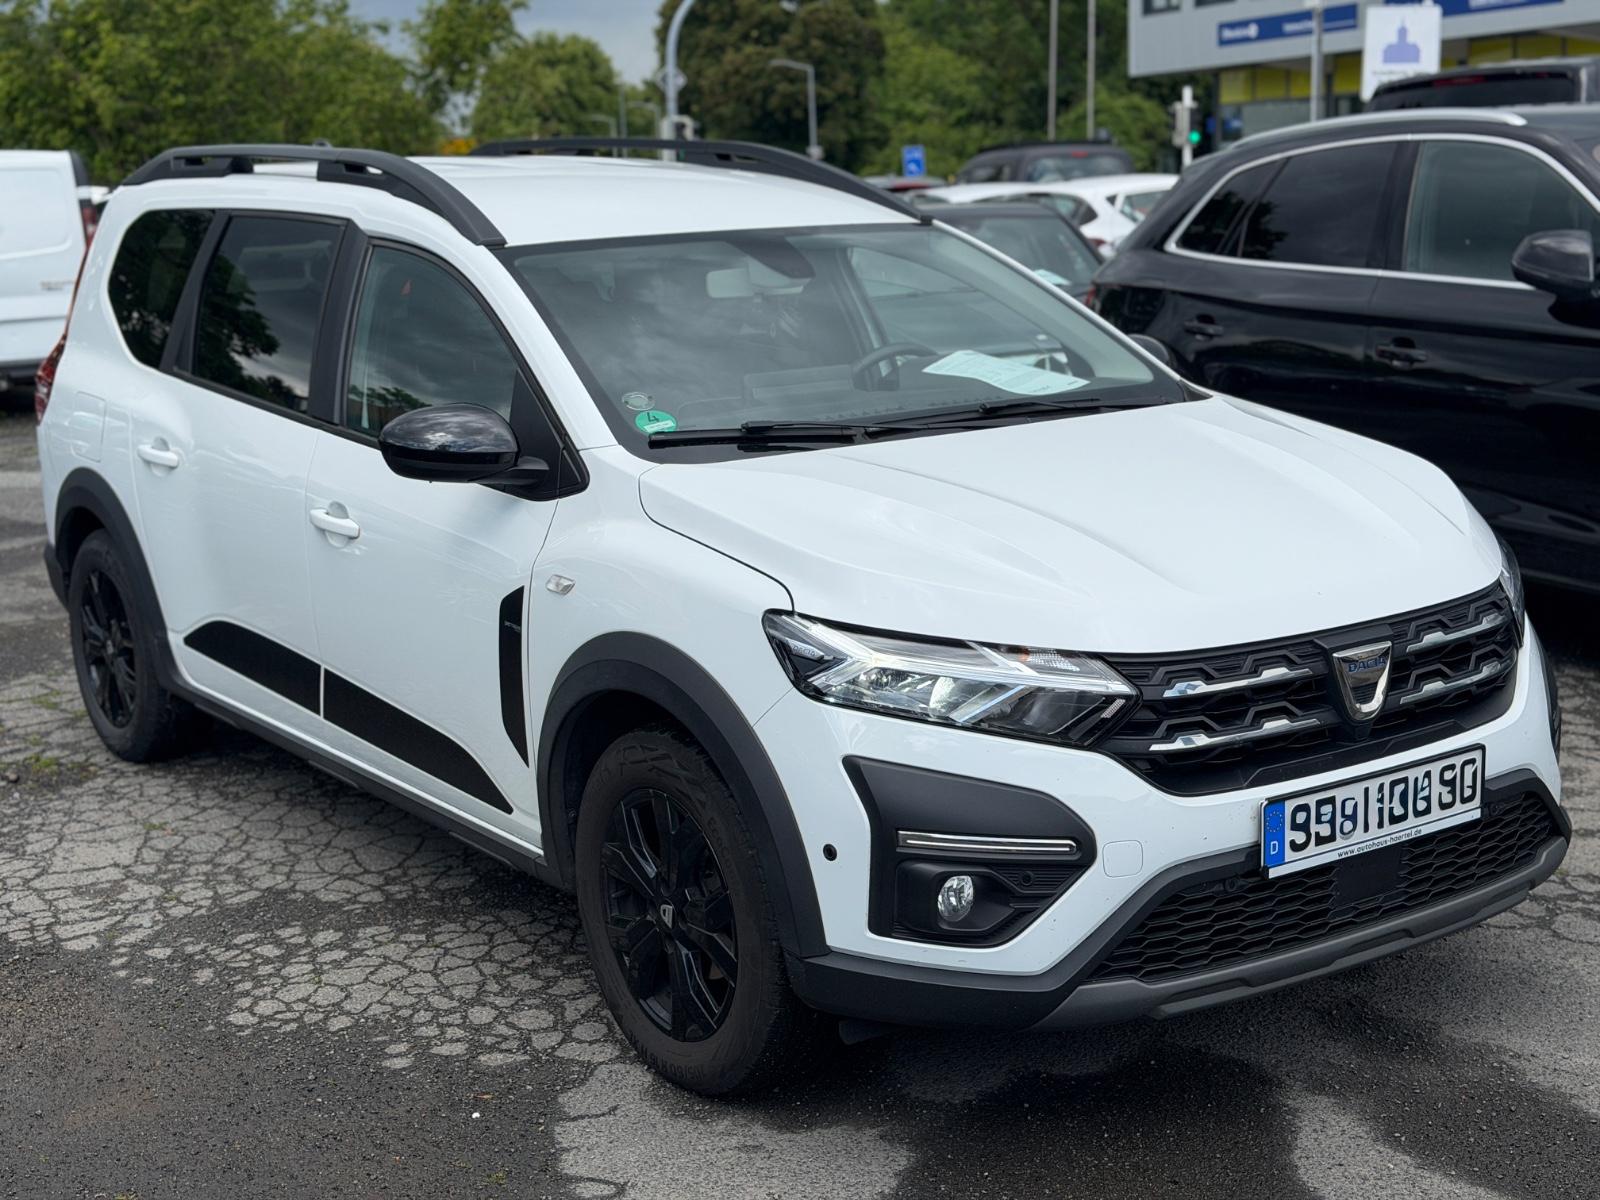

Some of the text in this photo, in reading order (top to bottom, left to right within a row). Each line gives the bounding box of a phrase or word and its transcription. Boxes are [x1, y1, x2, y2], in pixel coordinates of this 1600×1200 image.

[647, 411, 659, 422] 4
[1348, 655, 1386, 673] DACIA
[1270, 840, 1278, 855] D
[1337, 828, 1422, 858] www.autohaus-haertel.de
